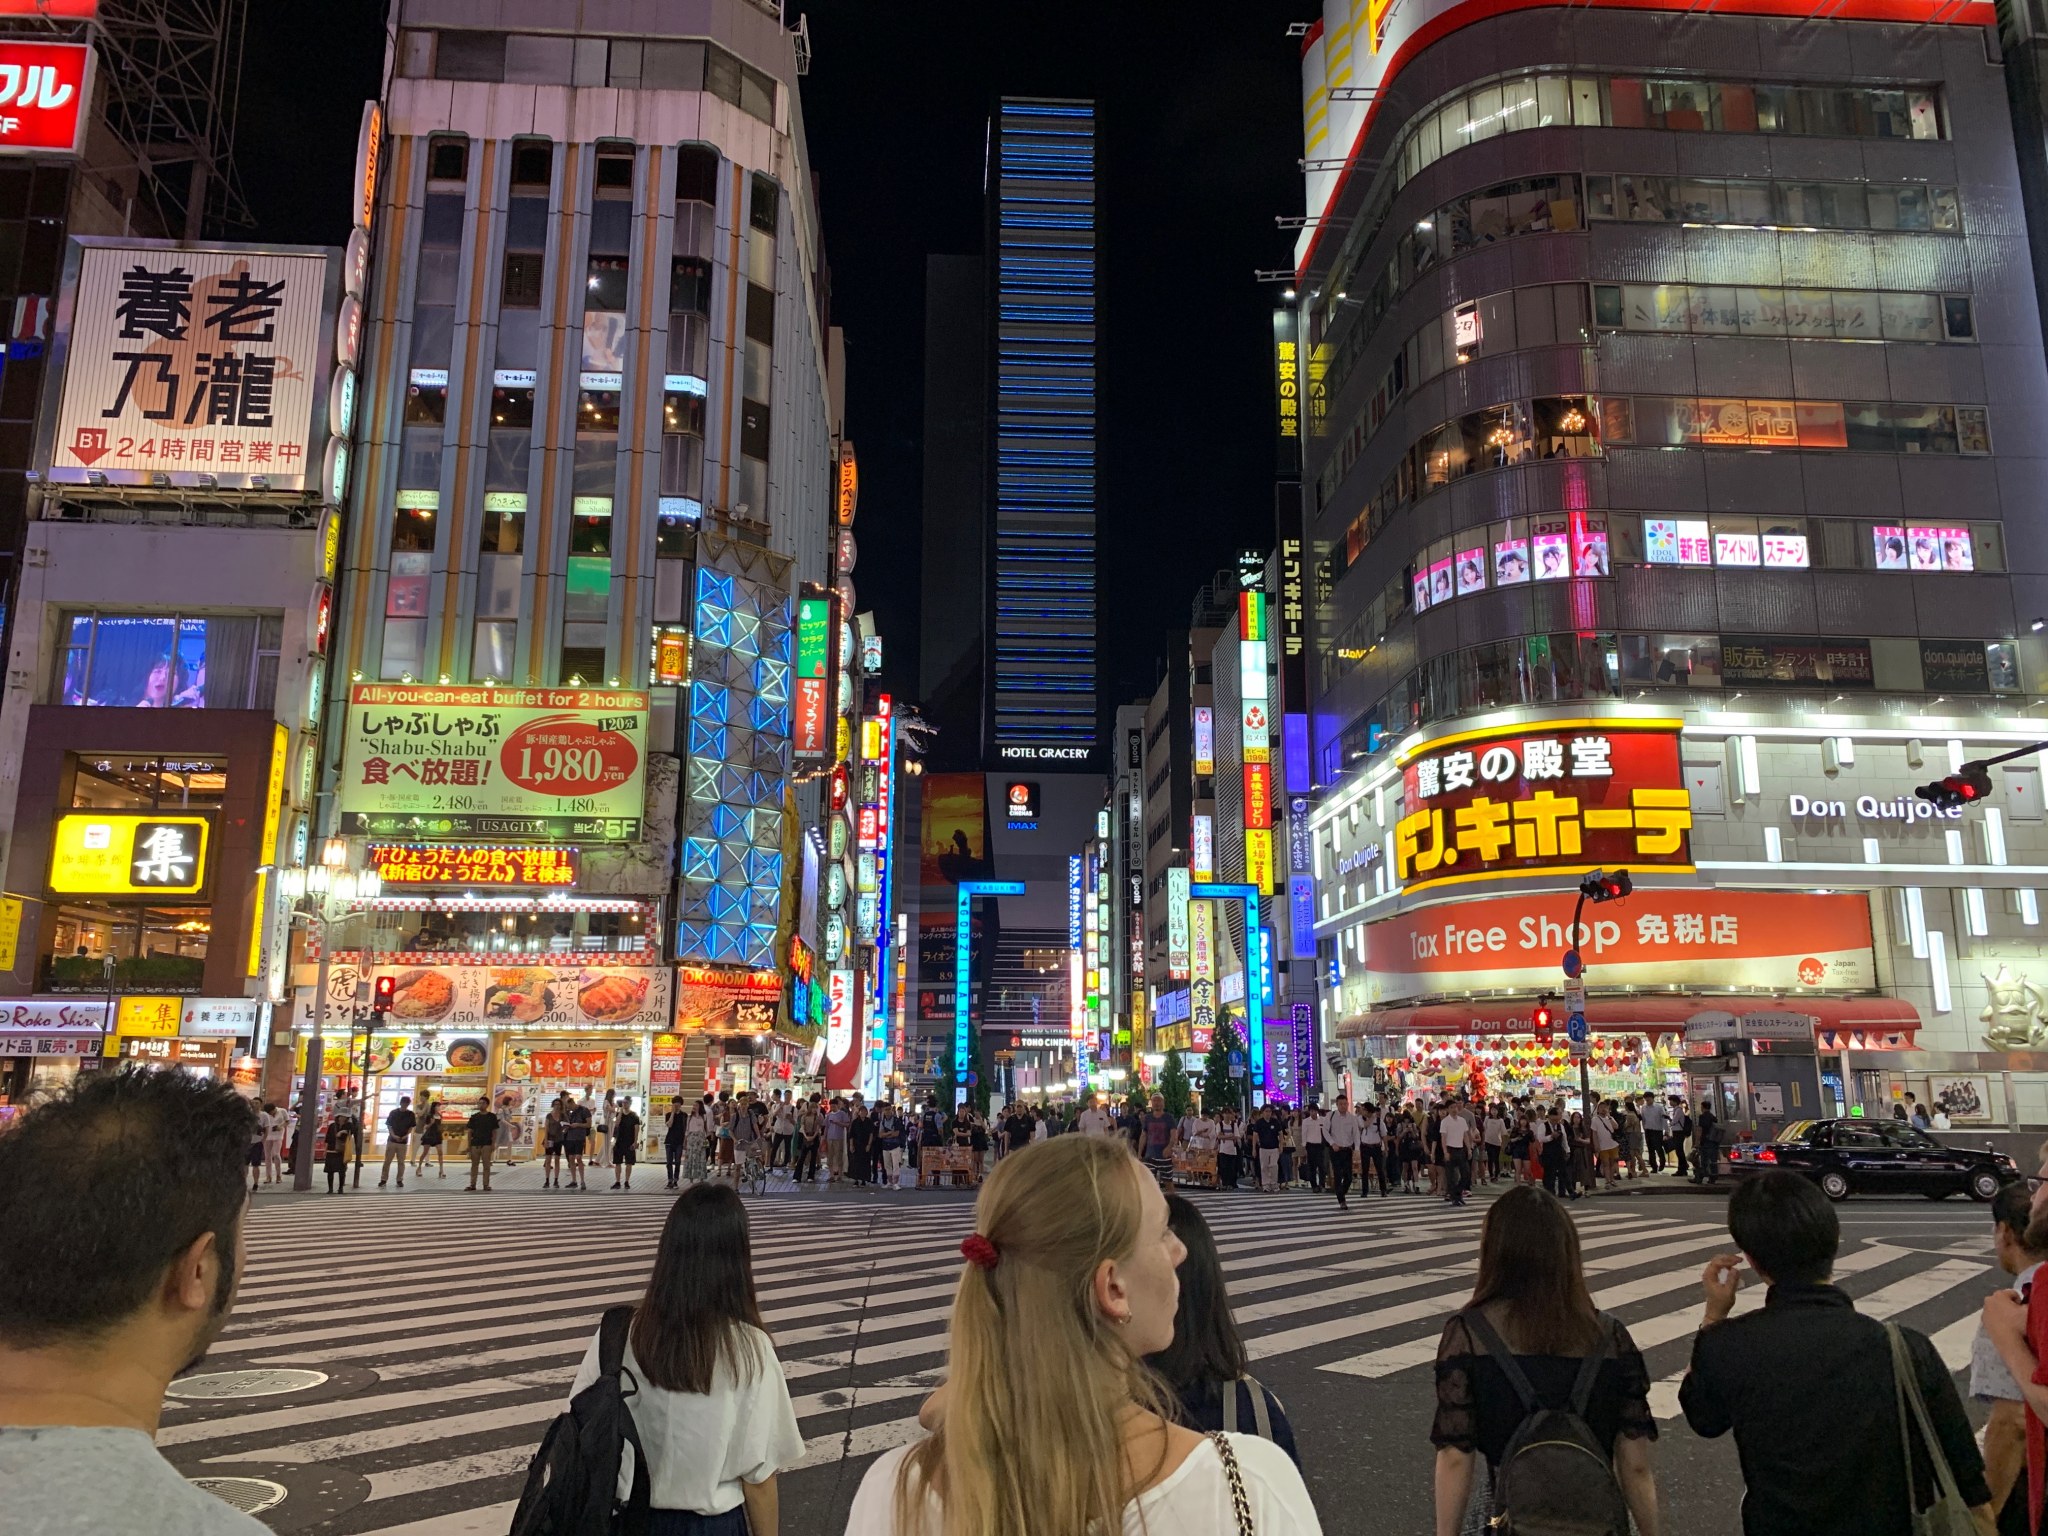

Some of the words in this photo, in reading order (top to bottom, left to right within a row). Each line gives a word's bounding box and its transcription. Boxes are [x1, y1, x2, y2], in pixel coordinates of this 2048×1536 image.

[115, 266, 285, 343] 養老
[101, 352, 276, 428] 乃瀧
[1279, 342, 1298, 437] 驚安の殿堂
[79, 433, 105, 450] B1
[117, 438, 302, 465] 24時間営業中
[1533, 522, 1605, 534] OPN
[1679, 537, 1709, 562] 新宿
[1718, 539, 1758, 563] アイドル
[1765, 541, 1805, 563] ステージ
[801, 634, 825, 643] サラダ
[800, 648, 825, 657] スイーツ
[1723, 646, 1765, 668] 販売
[1827, 652, 1869, 667] 時計
[804, 680, 820, 689] 新宿
[359, 688, 488, 704] All-you-can-eat
[493, 691, 543, 706] buffet
[548, 692, 574, 706] for
[578, 693, 590, 706] 2
[595, 693, 643, 708] hours
[362, 711, 502, 737] しゃぶしゃぶ
[602, 718, 635, 732] 120分
[803, 688, 820, 749] ひょうたん
[1001, 747, 1037, 758] HOTEL
[1039, 748, 1089, 759] GRACERY
[518, 747, 603, 785] 1,980
[603, 770, 625, 781] yen
[1417, 736, 1614, 799] 驚安の殿堂
[1789, 794, 1846, 817] Don
[482, 820, 545, 833] USAGIYA
[605, 819, 636, 838] 5F
[1007, 821, 1039, 831] IMAX
[134, 827, 194, 882] 集
[1353, 842, 1380, 868] Quijote
[1196, 903, 1207, 962] きんくら酒場
[1410, 930, 1438, 960] Tax
[1445, 922, 1508, 956] Free
[1519, 914, 1621, 954] Shop
[1637, 913, 1739, 945] 免税店
[958, 908, 969, 999] GODZILLA
[1833, 959, 1856, 967] Japan
[330, 968, 357, 999] 虎
[459, 970, 470, 989] そば
[684, 970, 749, 986] OKONOMI
[753, 973, 783, 987] YAKI
[1173, 969, 1188, 980] B1
[470, 969, 481, 1009] かき揚げ
[653, 969, 668, 1009] かつ丼
[831, 975, 844, 1028] トラノコ
[1193, 977, 1215, 1026] 金の蔵
[12, 1005, 52, 1028] Roko
[150, 1003, 176, 1030] 集
[1470, 1018, 1501, 1031] Don
[1744, 1018, 1806, 1028] 安全安心ステーション
[957, 1009, 967, 1053] ROAD
[1021, 1038, 1044, 1047] TOHO
[1296, 1008, 1310, 1066] カラオケ
[0, 1039, 33, 1054] ド品
[535, 1058, 606, 1073] とらそば
[1276, 1041, 1291, 1091] カラオケ
